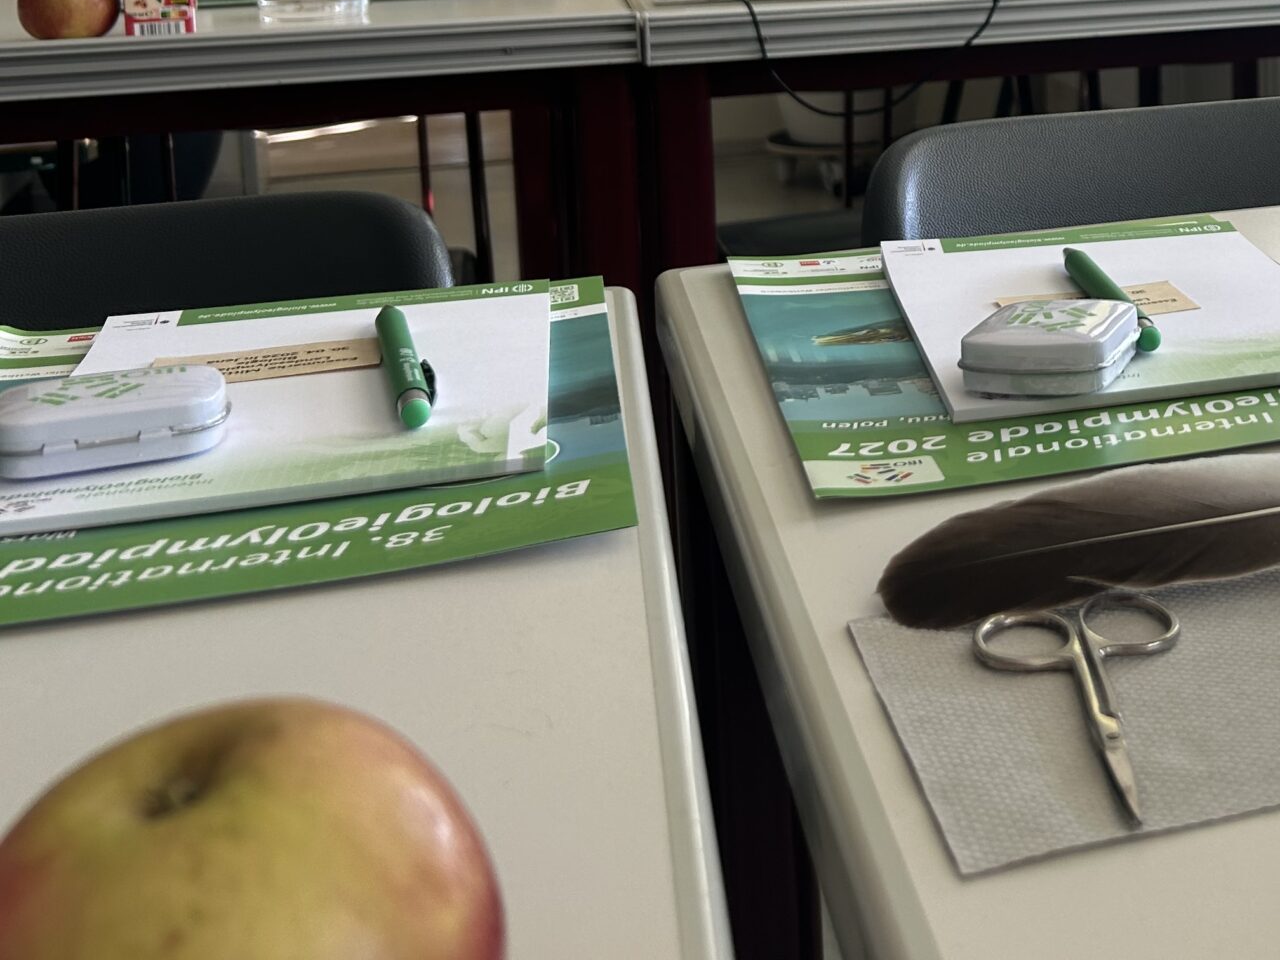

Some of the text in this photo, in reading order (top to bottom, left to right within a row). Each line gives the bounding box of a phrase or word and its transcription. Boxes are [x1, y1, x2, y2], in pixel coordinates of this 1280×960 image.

[1179, 224, 1204, 233] IPN
[480, 287, 510, 295] IPN
[822, 419, 888, 430] Polen
[827, 434, 947, 457] 2027
[966, 410, 1275, 466] Internationale
[370, 524, 454, 549] 38.
